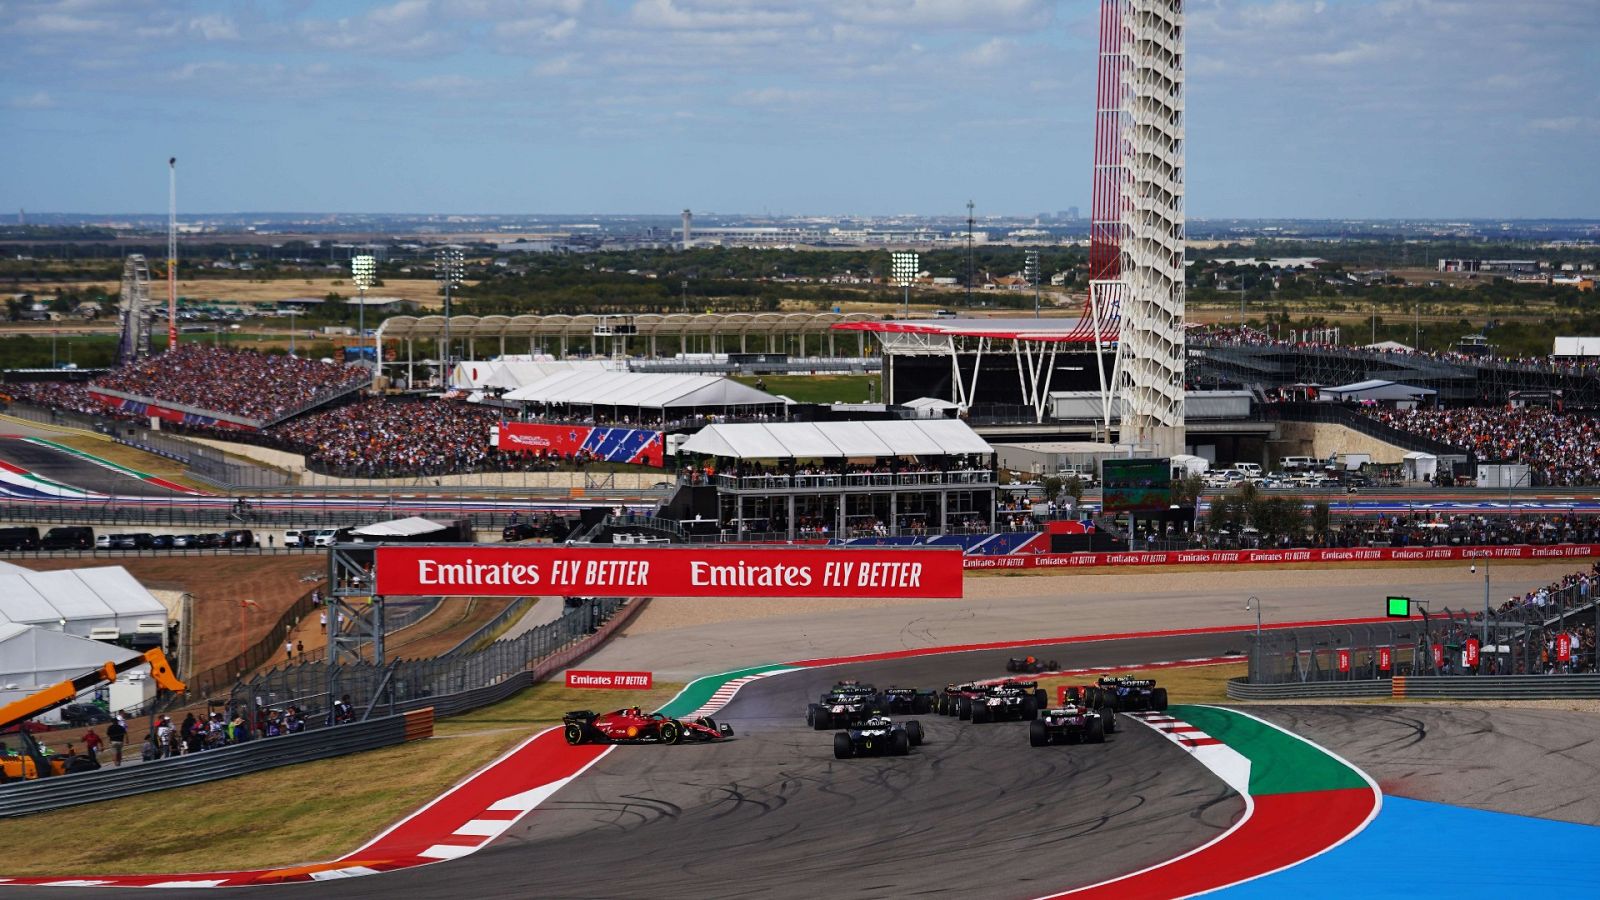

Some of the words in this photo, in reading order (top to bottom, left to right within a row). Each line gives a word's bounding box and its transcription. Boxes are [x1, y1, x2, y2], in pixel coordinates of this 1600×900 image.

[1321, 551, 1353, 560] Emirates
[1392, 550, 1424, 558] Emirates
[1462, 549, 1493, 558] Emirates
[1532, 548, 1563, 556] Emirates
[1035, 557, 1068, 566] Emirates
[1106, 555, 1139, 563] Emirates
[1178, 554, 1210, 562] Emirates
[1250, 553, 1282, 561] Emirates
[963, 559, 995, 568] Emirates
[418, 559, 540, 585] Emirates
[551, 560, 581, 585] FLY
[585, 560, 649, 586] BETTER
[690, 560, 812, 586] Emirates
[823, 562, 854, 587] FLY
[857, 562, 922, 588] BETTER
[570, 675, 612, 685] Emirates
[614, 675, 625, 685] FLY
[625, 676, 648, 686] BETTER
